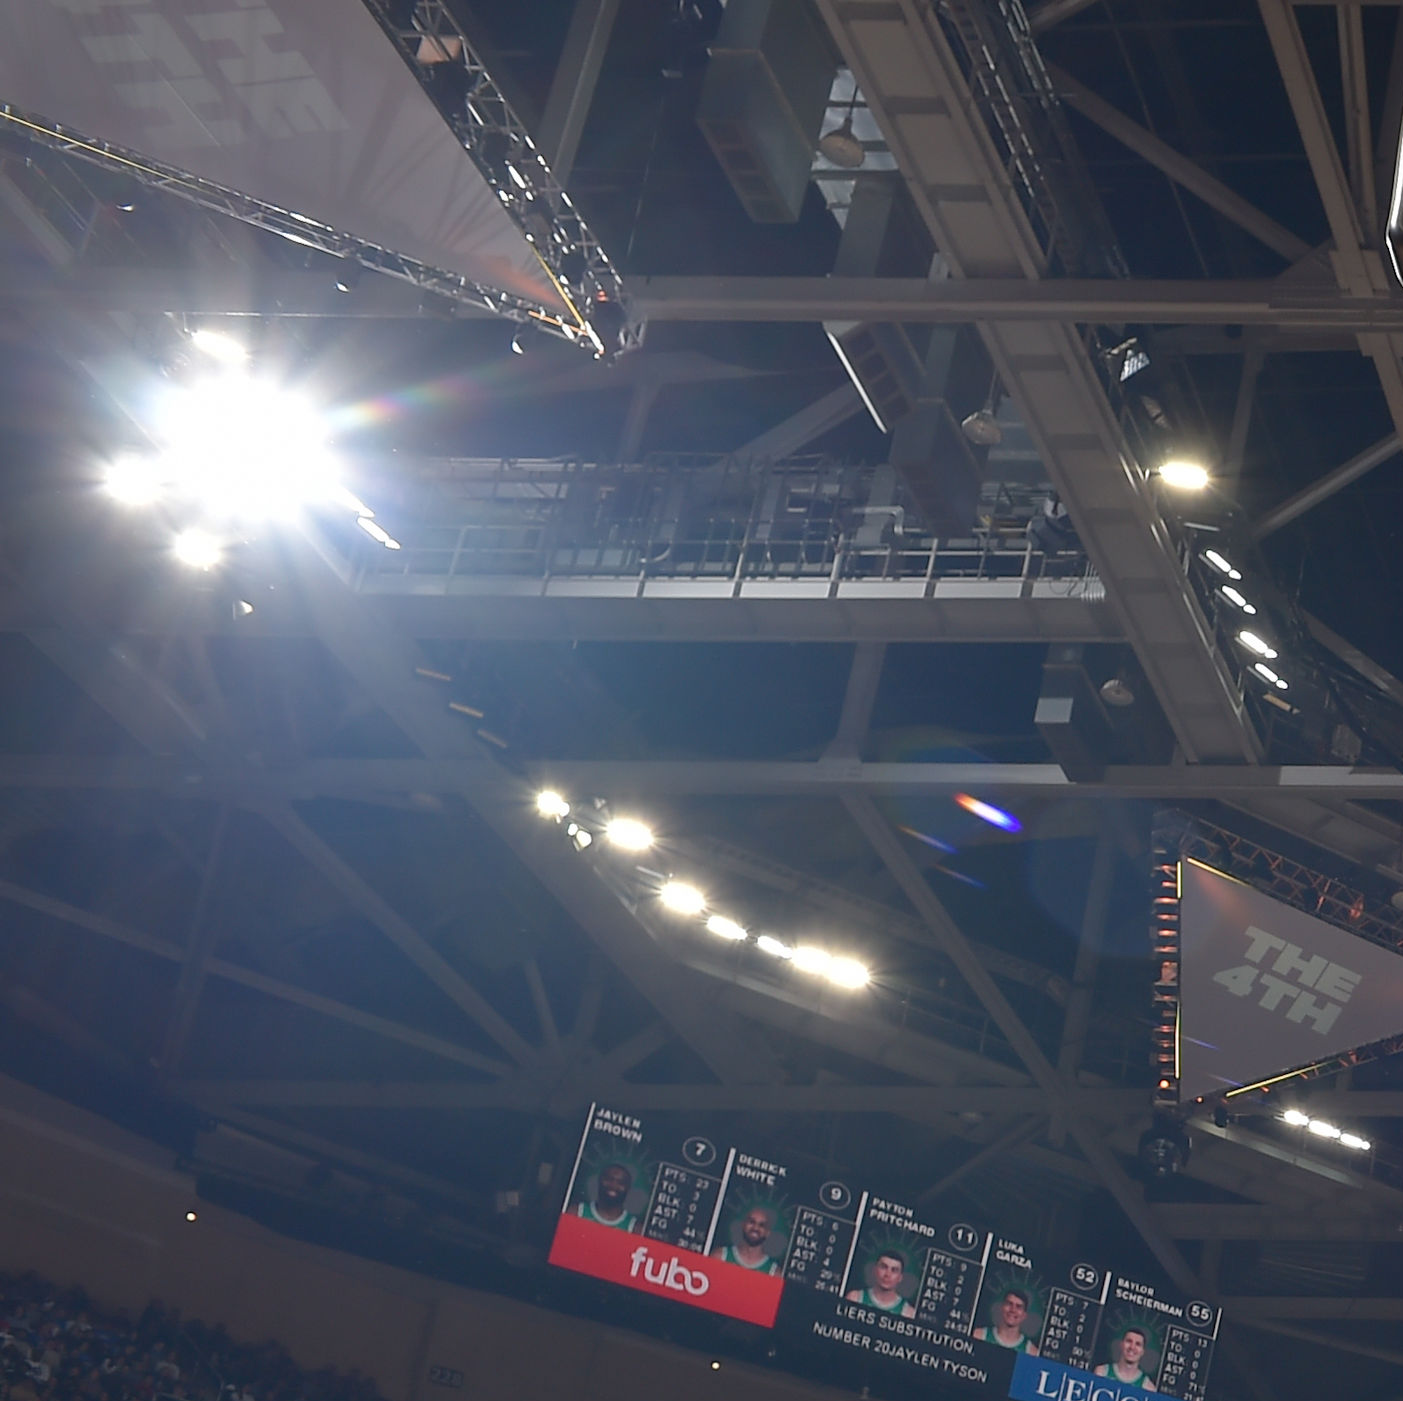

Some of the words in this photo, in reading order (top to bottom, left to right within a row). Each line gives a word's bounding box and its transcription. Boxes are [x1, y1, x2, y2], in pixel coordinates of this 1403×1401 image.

[1243, 925, 1362, 1004] THE
[1212, 964, 1343, 1036] 4TH
[597, 1108, 641, 1129] JAYLEN
[593, 1119, 643, 1143] BROWN
[695, 1143, 706, 1155] 7
[735, 1165, 776, 1186] WHITE
[738, 1154, 787, 1177] DERRICK
[830, 1188, 842, 1200] 9
[872, 1197, 914, 1218] PAYTON
[869, 1208, 936, 1238] PRITCHARD
[956, 1229, 974, 1246] 11
[998, 1238, 1024, 1255] LUKA
[995, 1249, 1033, 1269] GARZA
[629, 1246, 709, 1296] fubo
[1076, 1269, 1096, 1283] 52
[1115, 1288, 1184, 1318] SCHEIERMAN
[1190, 1306, 1210, 1321] 55
[836, 1303, 876, 1327] LIERS
[812, 1320, 871, 1350] NUMBER
[942, 1359, 988, 1383] TYSON
